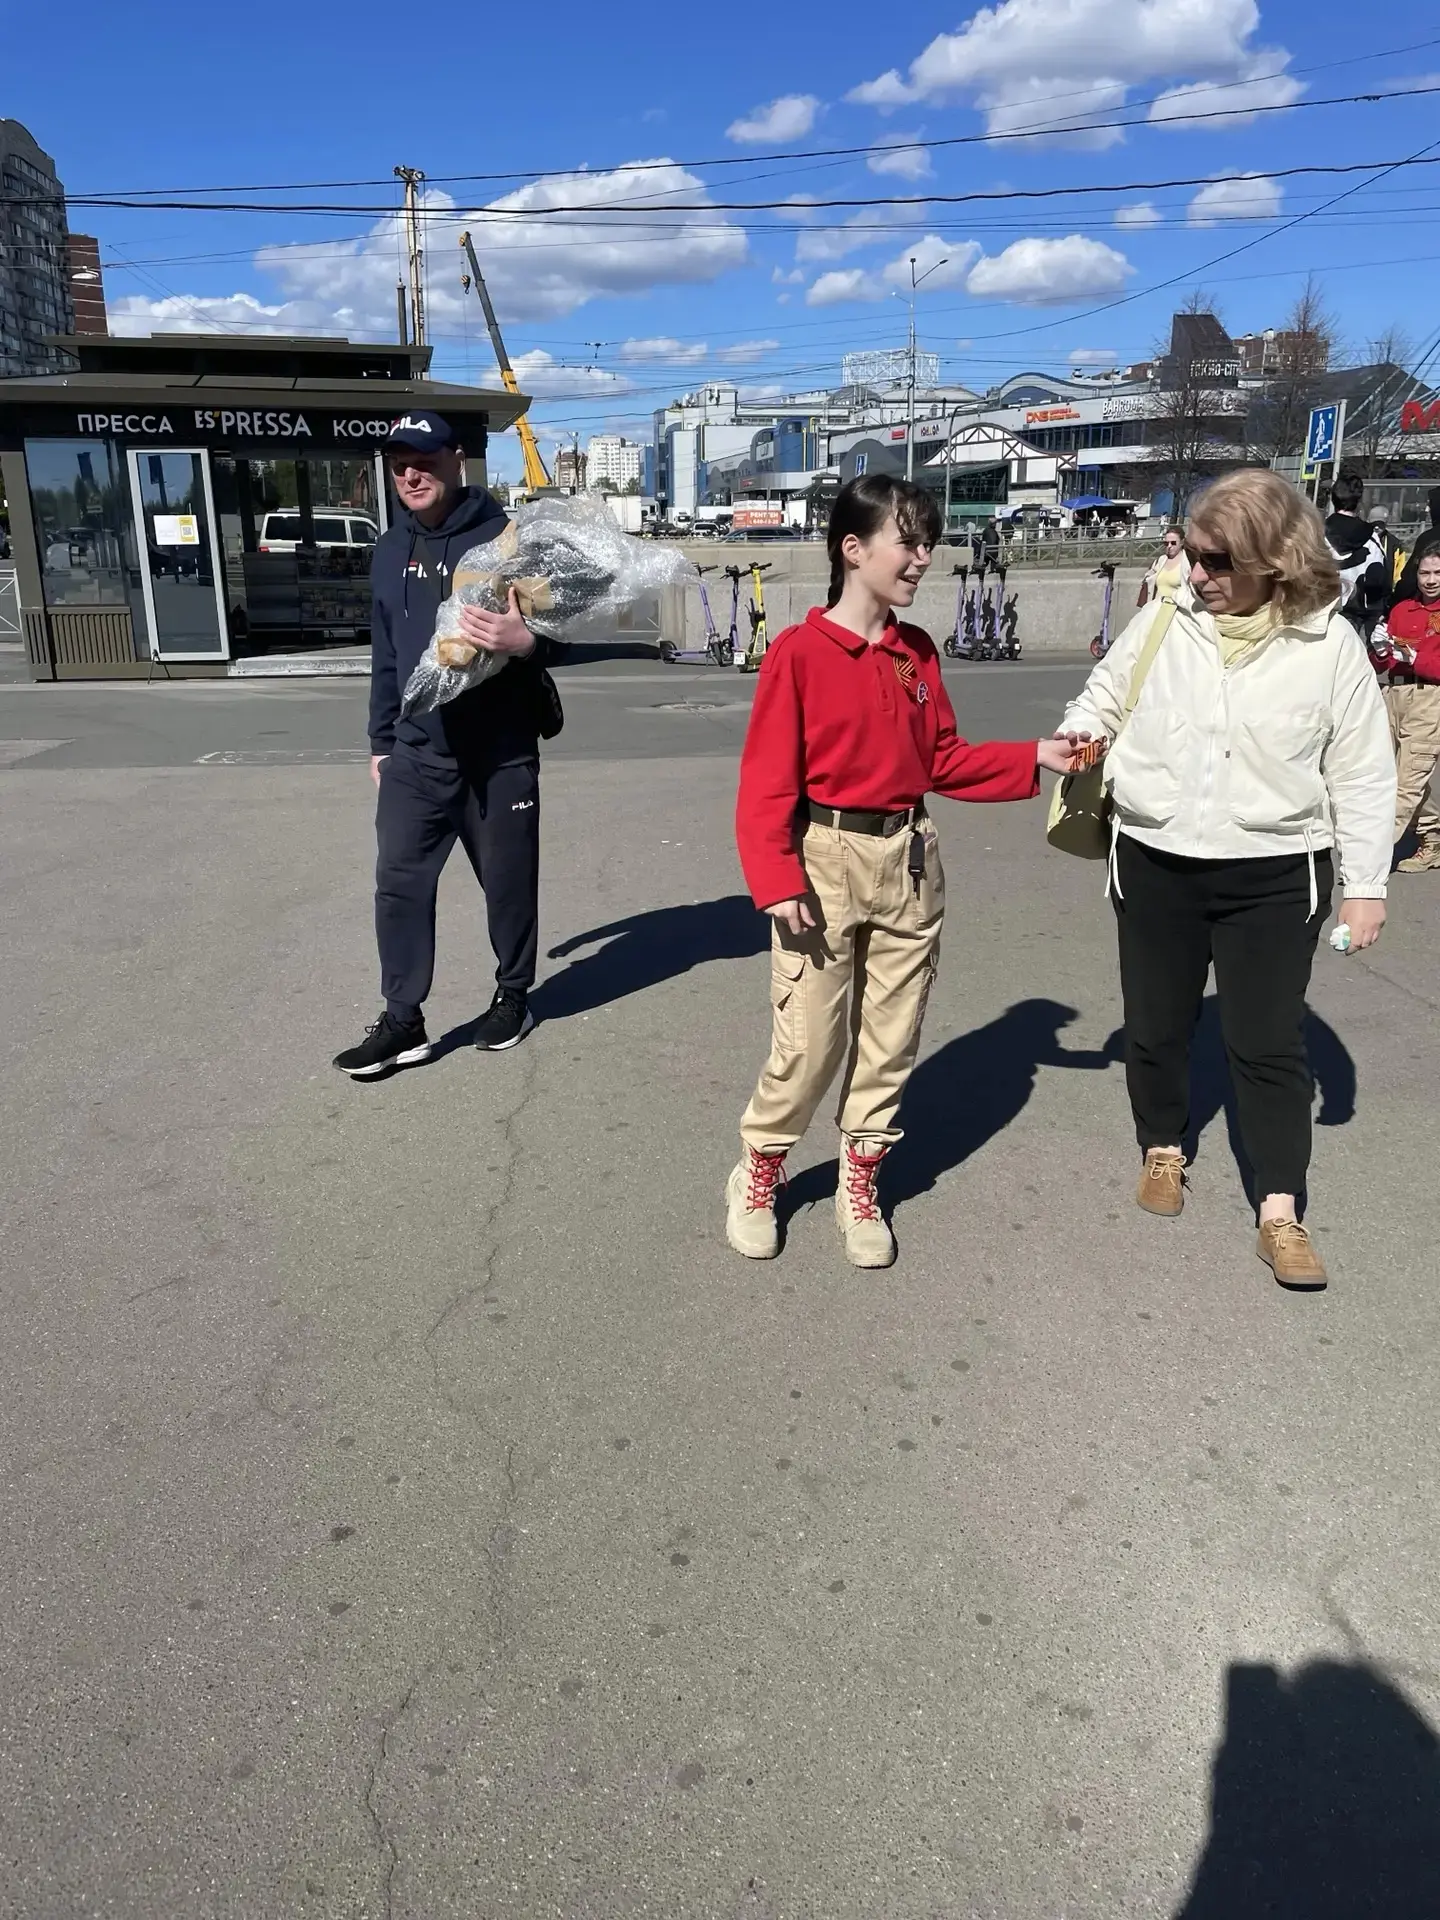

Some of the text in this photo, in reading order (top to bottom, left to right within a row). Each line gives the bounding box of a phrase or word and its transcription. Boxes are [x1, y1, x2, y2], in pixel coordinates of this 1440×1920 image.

[77, 413, 174, 434] ПРЕССА
[389, 415, 432, 436] FILA
[1026, 410, 1049, 424] DNS
[333, 419, 397, 437] КОФ
[511, 799, 534, 811] FILA
